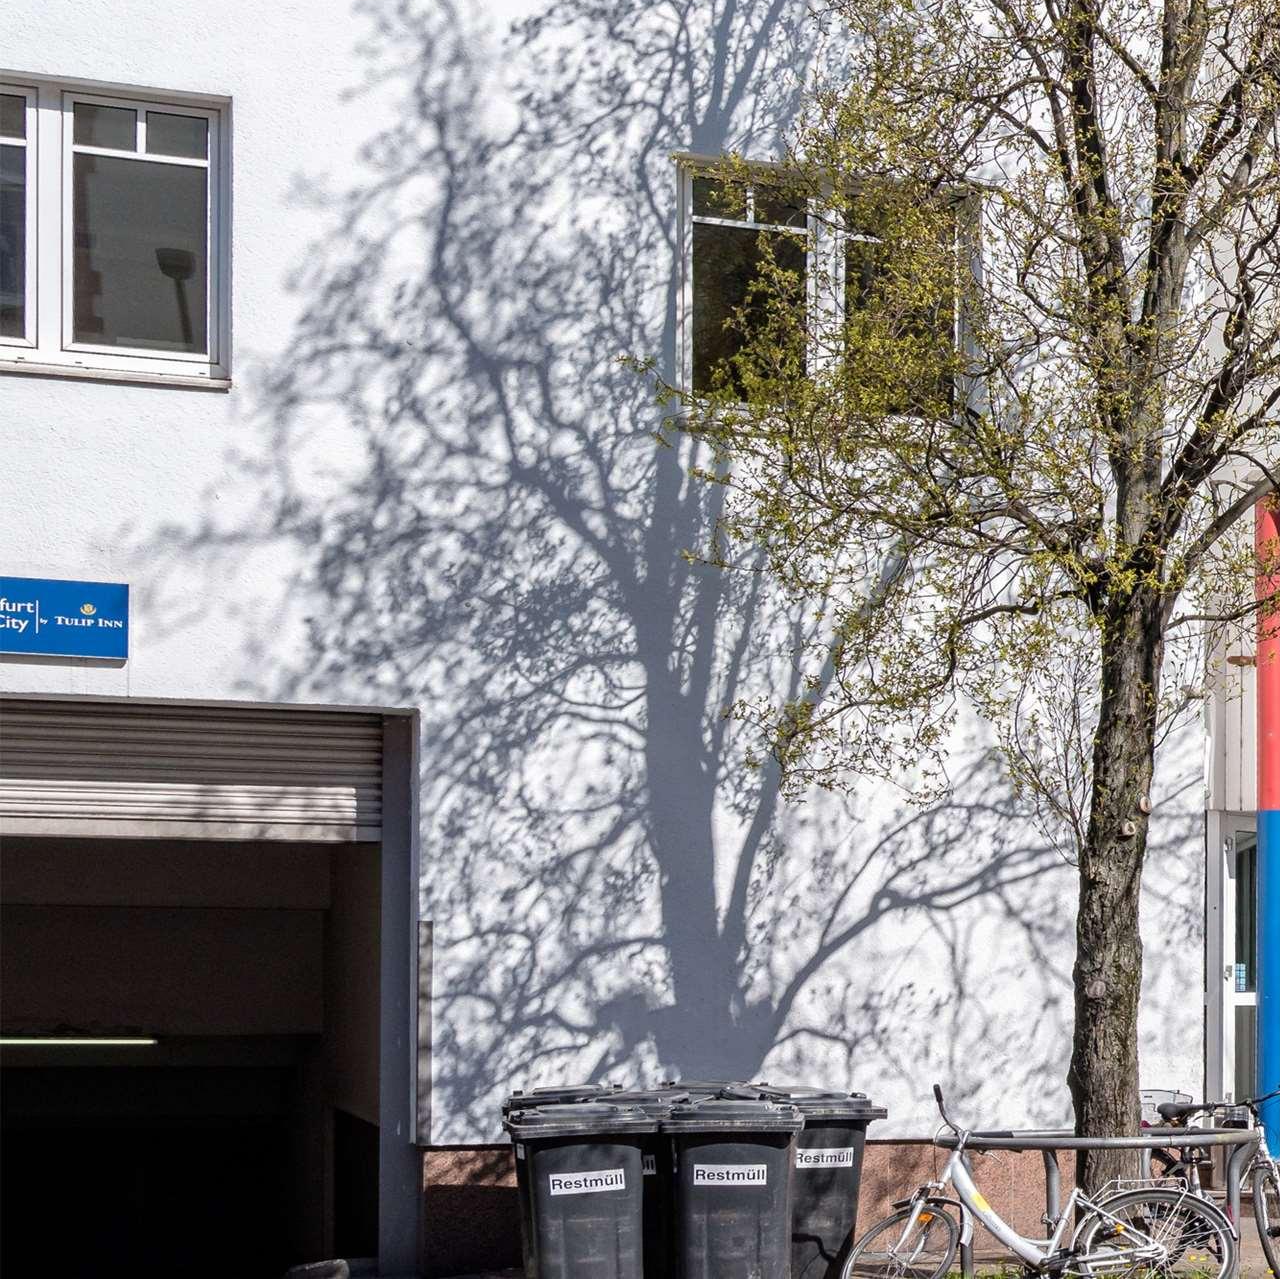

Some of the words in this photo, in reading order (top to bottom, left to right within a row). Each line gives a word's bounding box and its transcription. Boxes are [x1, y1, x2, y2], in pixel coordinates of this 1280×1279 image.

[54, 616, 95, 627] TULIP
[98, 619, 123, 628] INN
[695, 1168, 765, 1181] Restmüll
[551, 1173, 624, 1190] Restmüll
